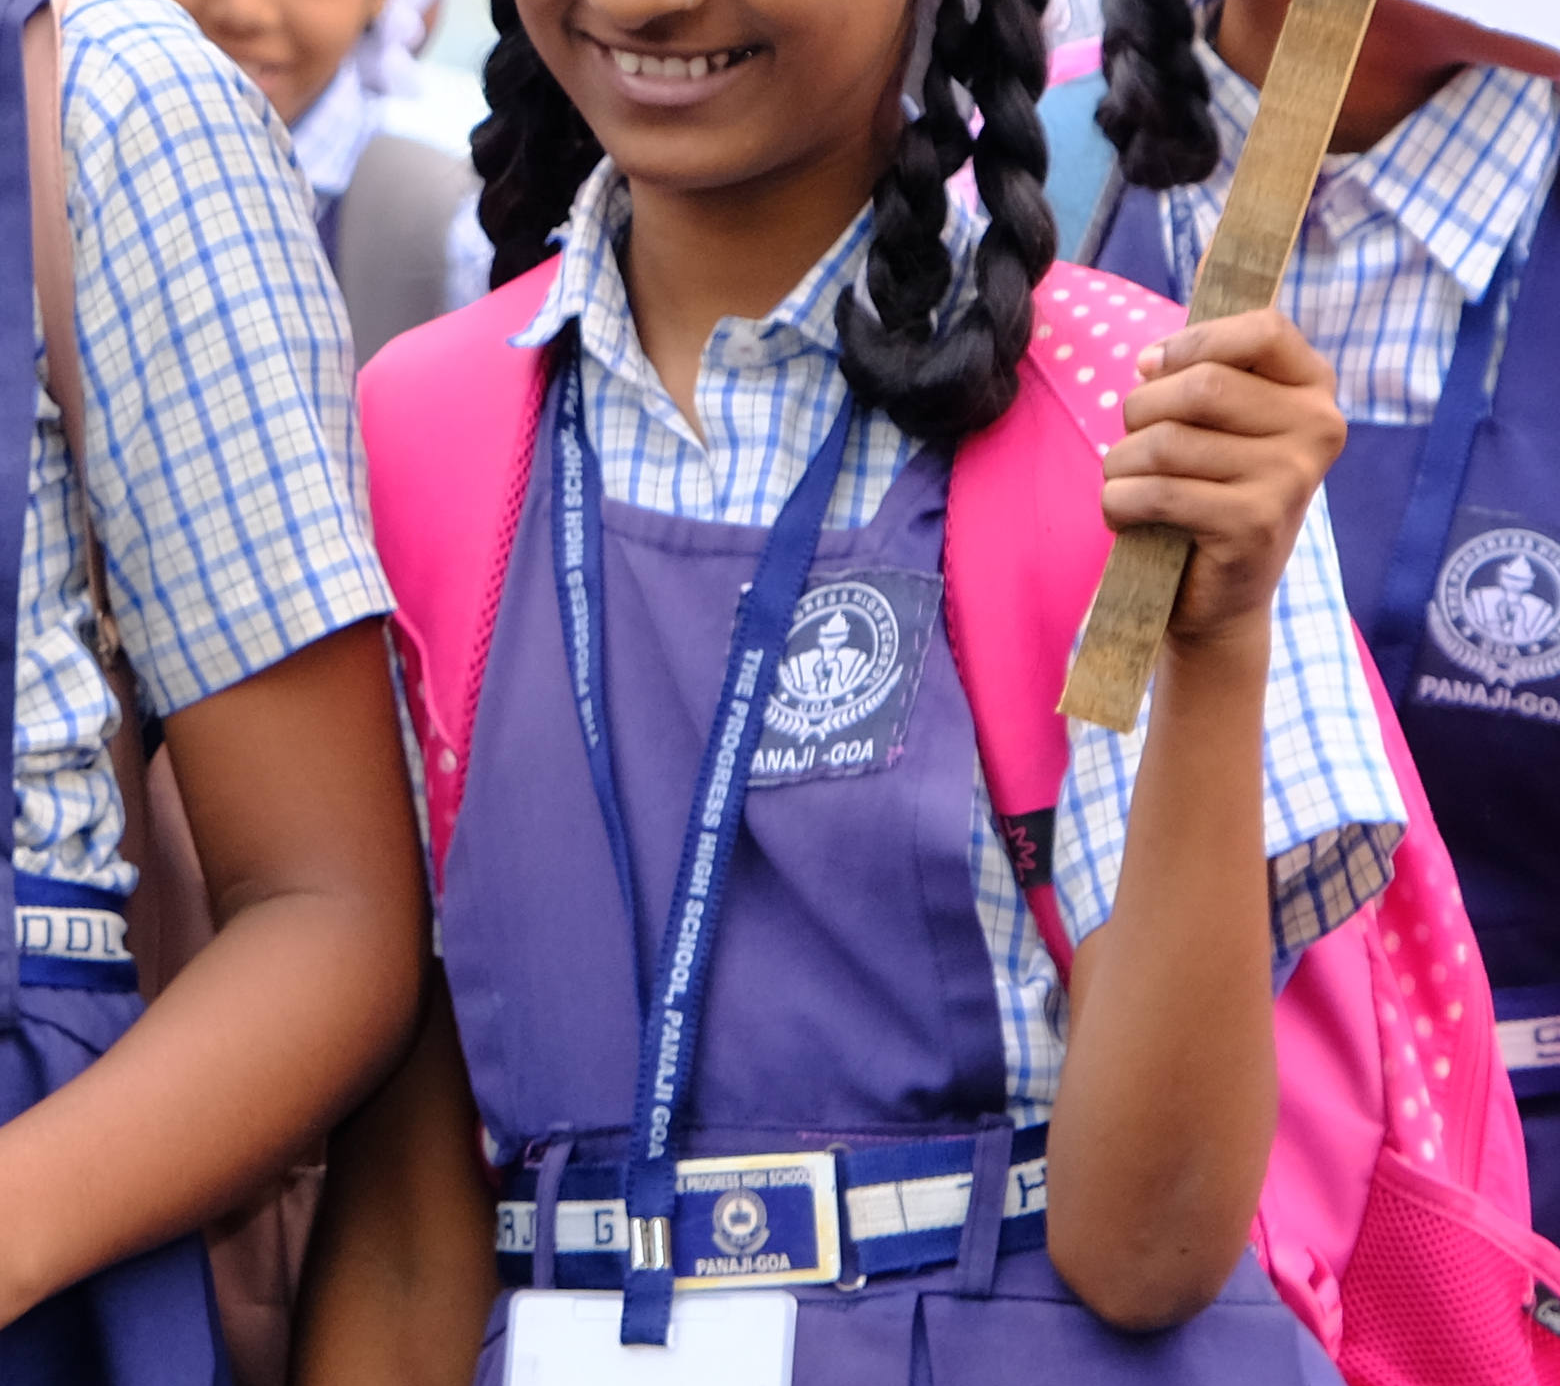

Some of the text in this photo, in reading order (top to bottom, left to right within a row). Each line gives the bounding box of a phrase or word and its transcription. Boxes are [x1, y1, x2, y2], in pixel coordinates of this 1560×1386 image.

[563, 511, 584, 569] HIGH
[566, 569, 590, 697] PROGRESS
[735, 647, 764, 699] THE
[702, 699, 750, 830] PROGRESS
[750, 744, 816, 776] ANAJI
[689, 831, 718, 897] HIGH
[654, 1009, 684, 1102] PANAJI
[647, 1104, 672, 1160] GOA
[695, 1251, 792, 1277] PANAJI-GOA
